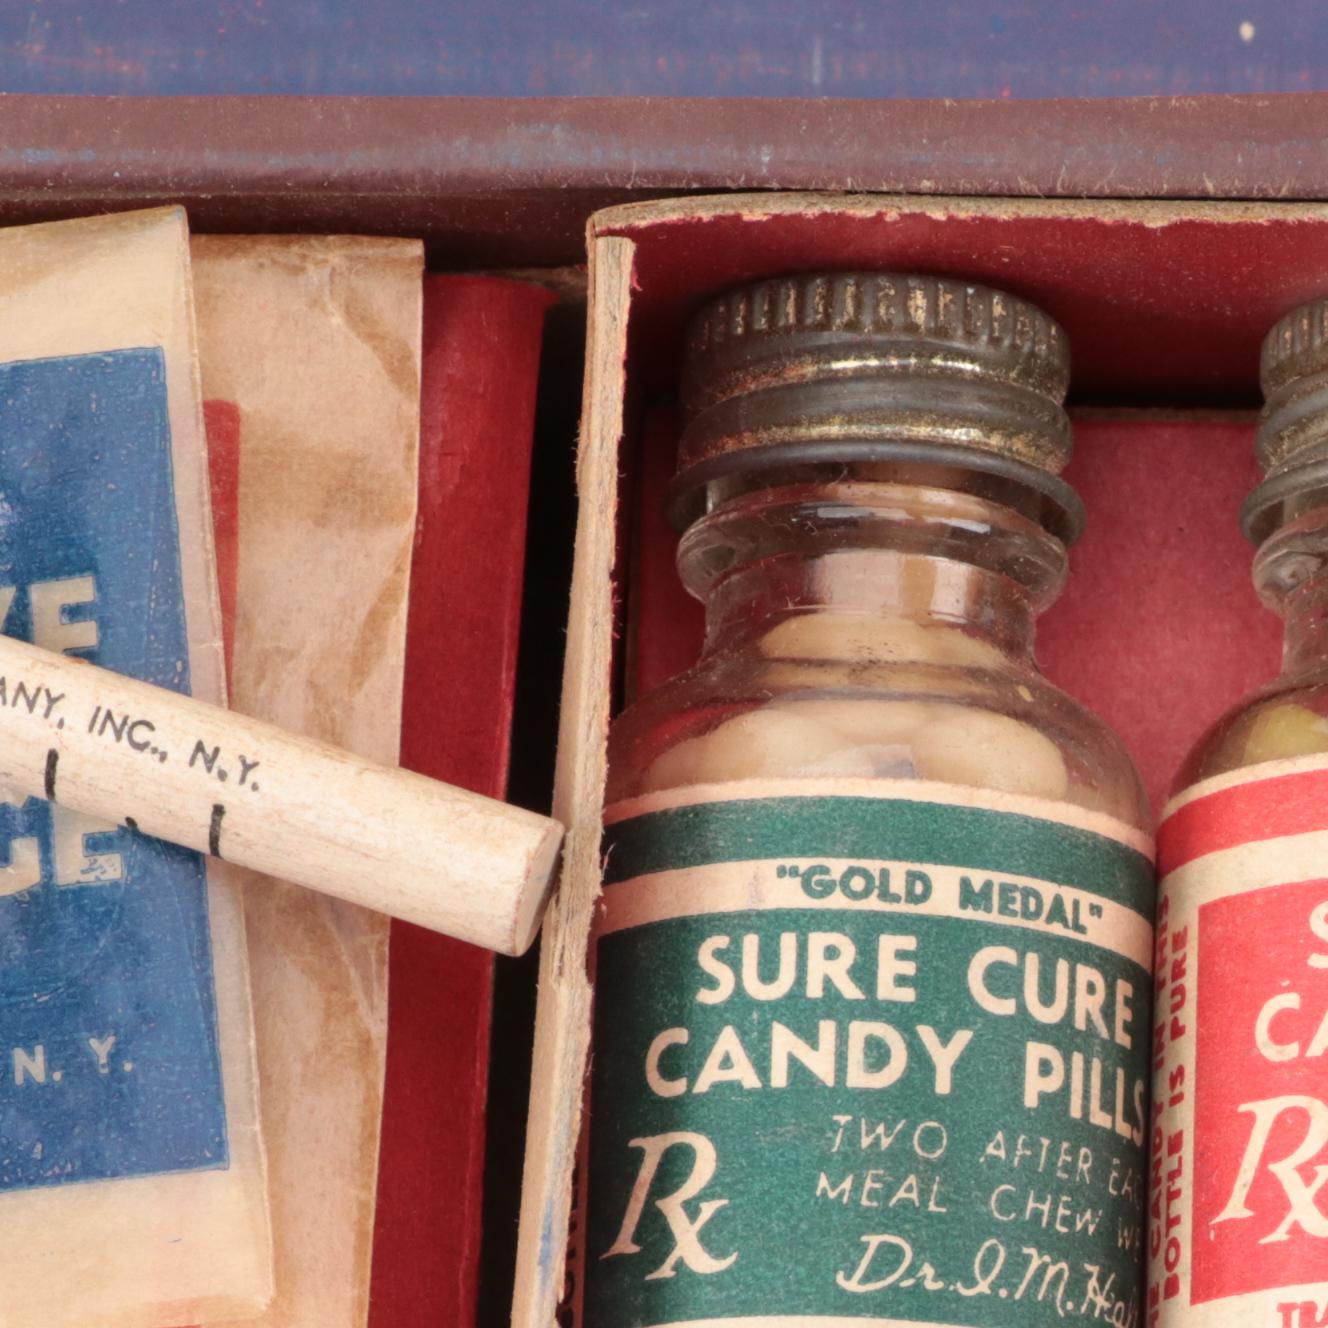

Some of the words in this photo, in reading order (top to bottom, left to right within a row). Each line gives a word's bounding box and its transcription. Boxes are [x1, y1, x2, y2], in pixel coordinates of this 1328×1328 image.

[0, 677, 65, 730] NY,
[88, 706, 168, 763] INC.,
[777, 864, 932, 906] "GOLD
[958, 876, 1103, 934] MEDAL"
[696, 931, 918, 1005] SURE
[966, 944, 1134, 1051] CURE
[1169, 925, 1189, 1042] PURE
[645, 1019, 974, 1098] CANDY
[1022, 1040, 1146, 1147] PILLS
[1169, 1063, 1186, 1108] IS
[831, 1114, 948, 1160] TWO
[979, 1129, 1093, 1185] AFTER
[815, 1168, 947, 1214] MEAL
[990, 1184, 1103, 1238] CHEW
[1163, 1128, 1184, 1301] BOTTLE
